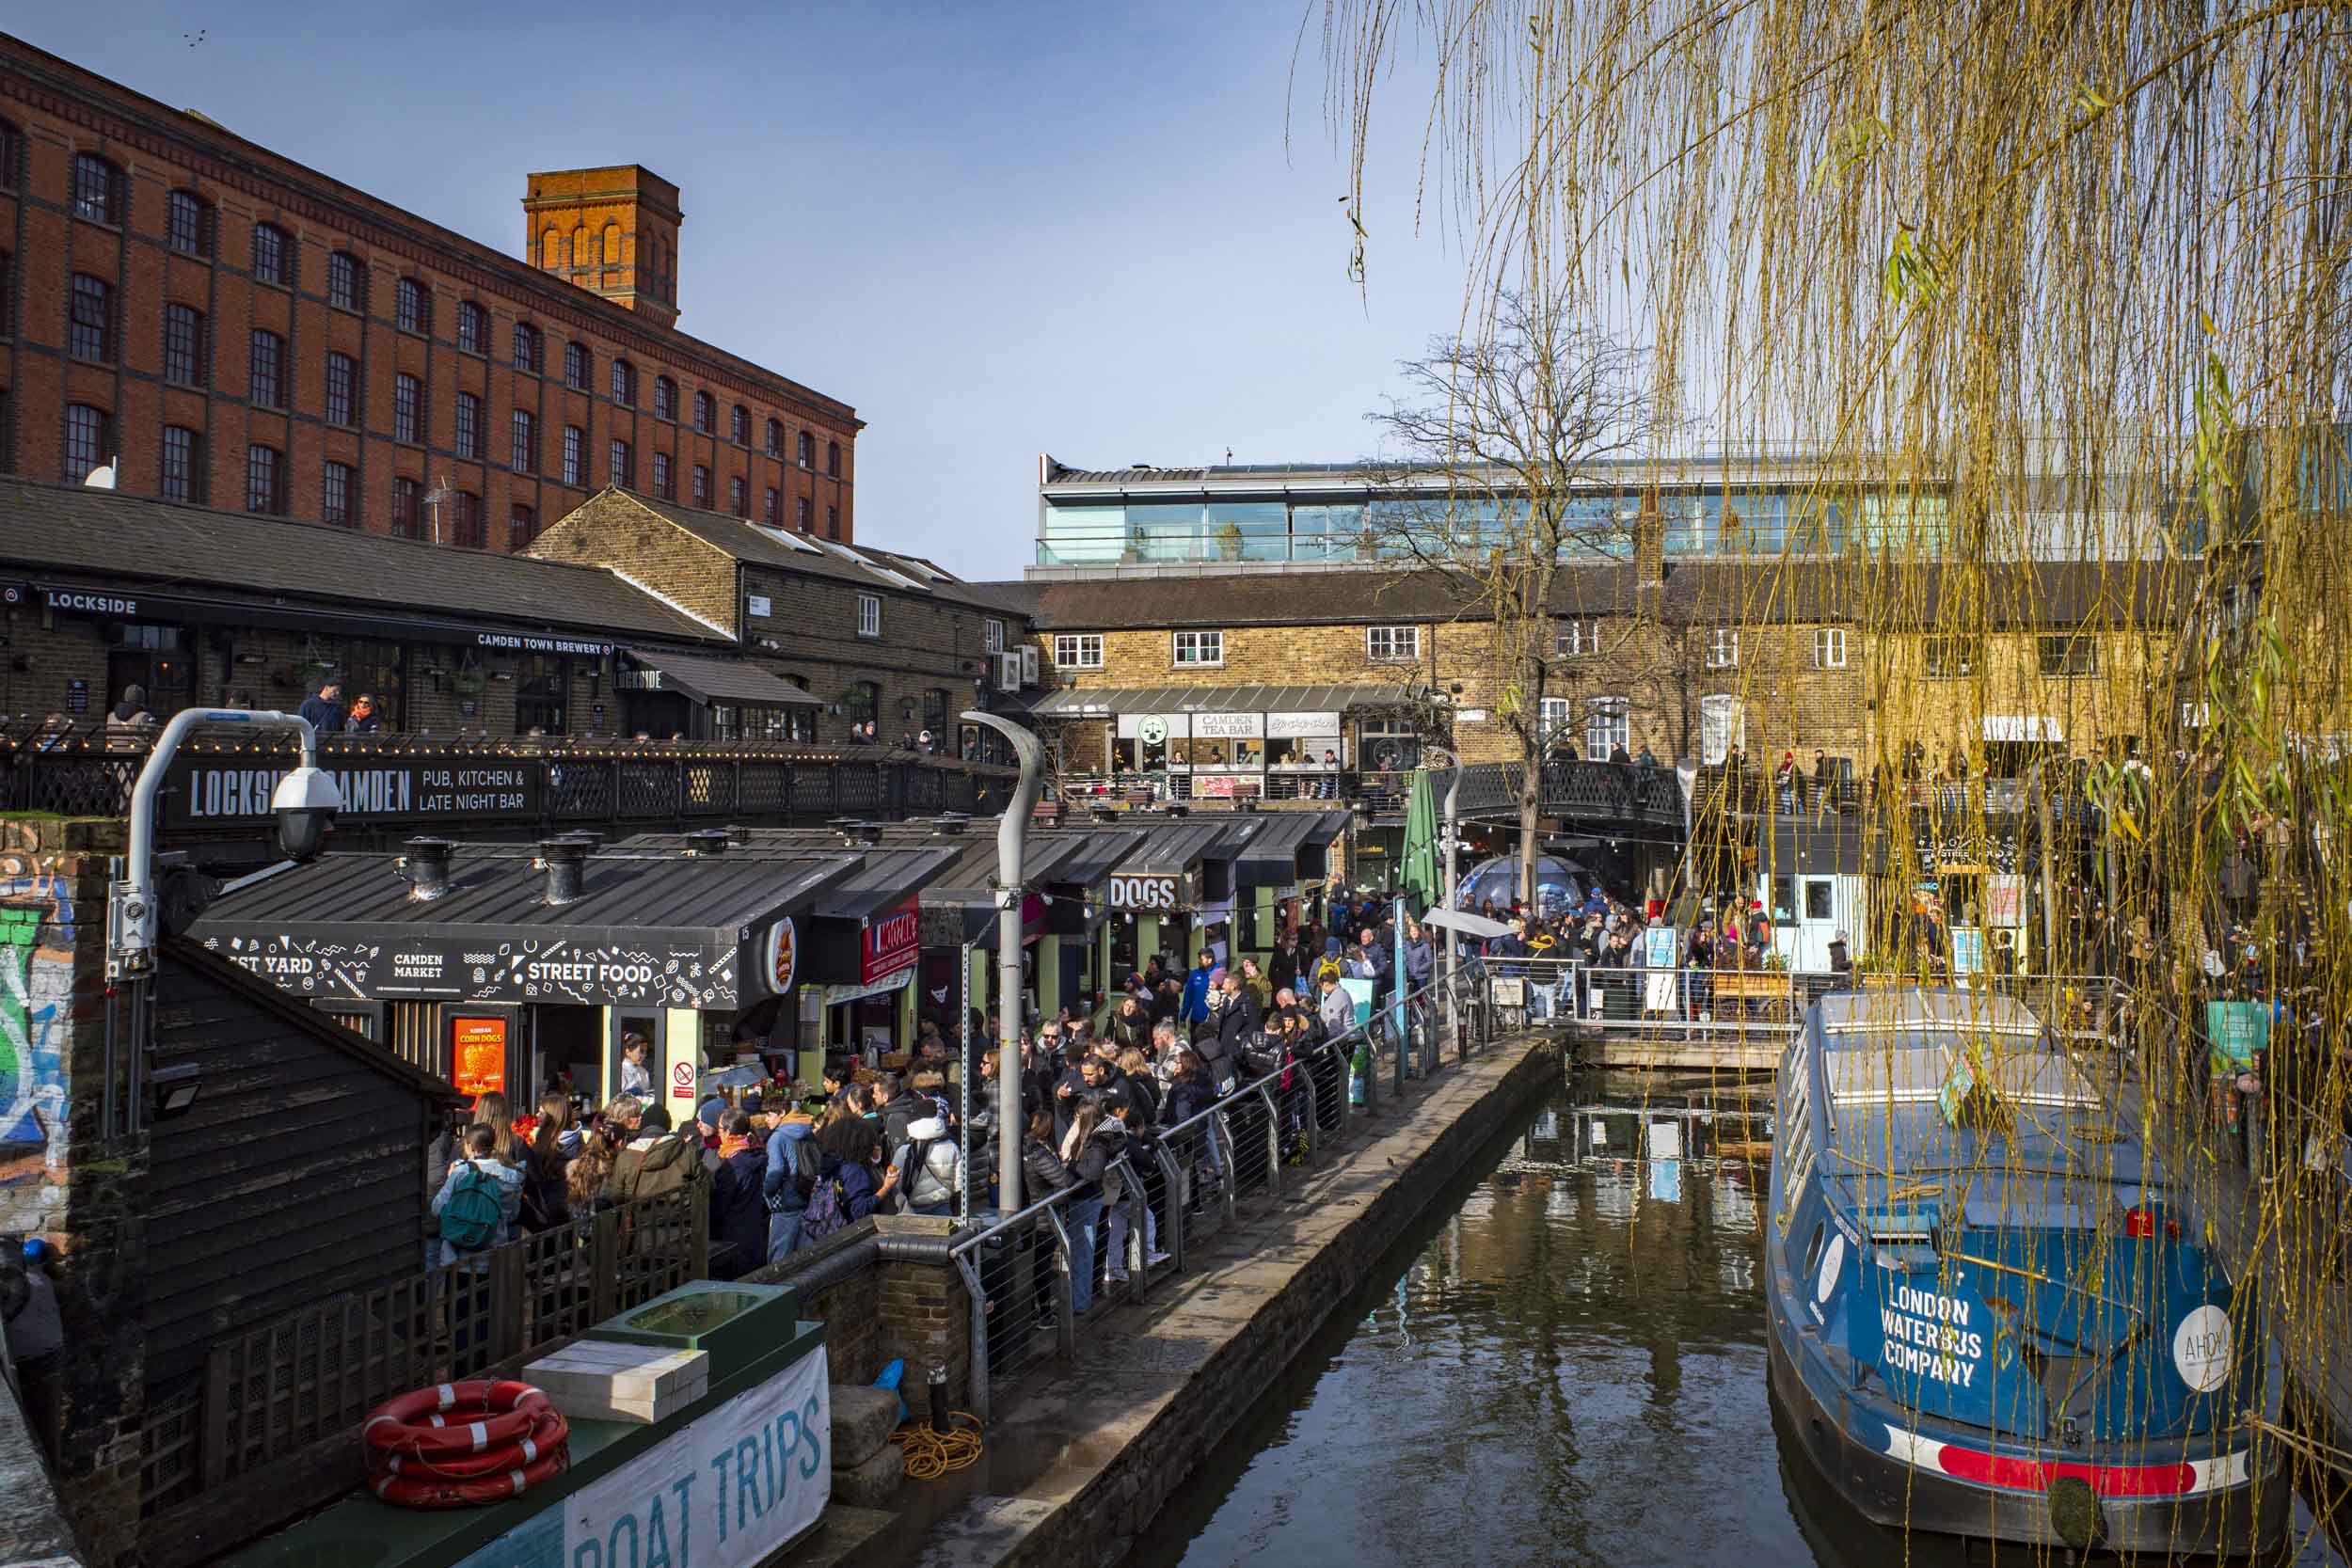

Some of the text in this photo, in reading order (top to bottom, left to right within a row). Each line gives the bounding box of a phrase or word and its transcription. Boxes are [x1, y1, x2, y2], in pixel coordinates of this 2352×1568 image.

[48, 593, 136, 614] LOCKSIDE
[478, 634, 600, 655] CAMDEN TOWN BREWERY
[1203, 715, 1252, 725] CAMDEN
[1203, 725, 1252, 735] TEA BAR
[422, 770, 524, 788] PUB, KITCHEN &
[190, 769, 410, 816] LOCKSI AMDEN
[420, 793, 524, 811] LATE NIGHT BAR
[1111, 878, 1175, 909] DOGS
[741, 927, 750, 941] 15
[265, 957, 313, 974] YARD
[394, 954, 443, 965] CAMDEN
[394, 966, 443, 978] MARKET
[528, 963, 652, 983] STREET FOOD
[459, 1034, 502, 1043] CORN DOGS
[1889, 1284, 1969, 1325] LONDON
[1882, 1308, 1981, 1359] WATERBUS
[1884, 1338, 1975, 1387] COMPANY
[710, 1394, 821, 1544] TRIPS
